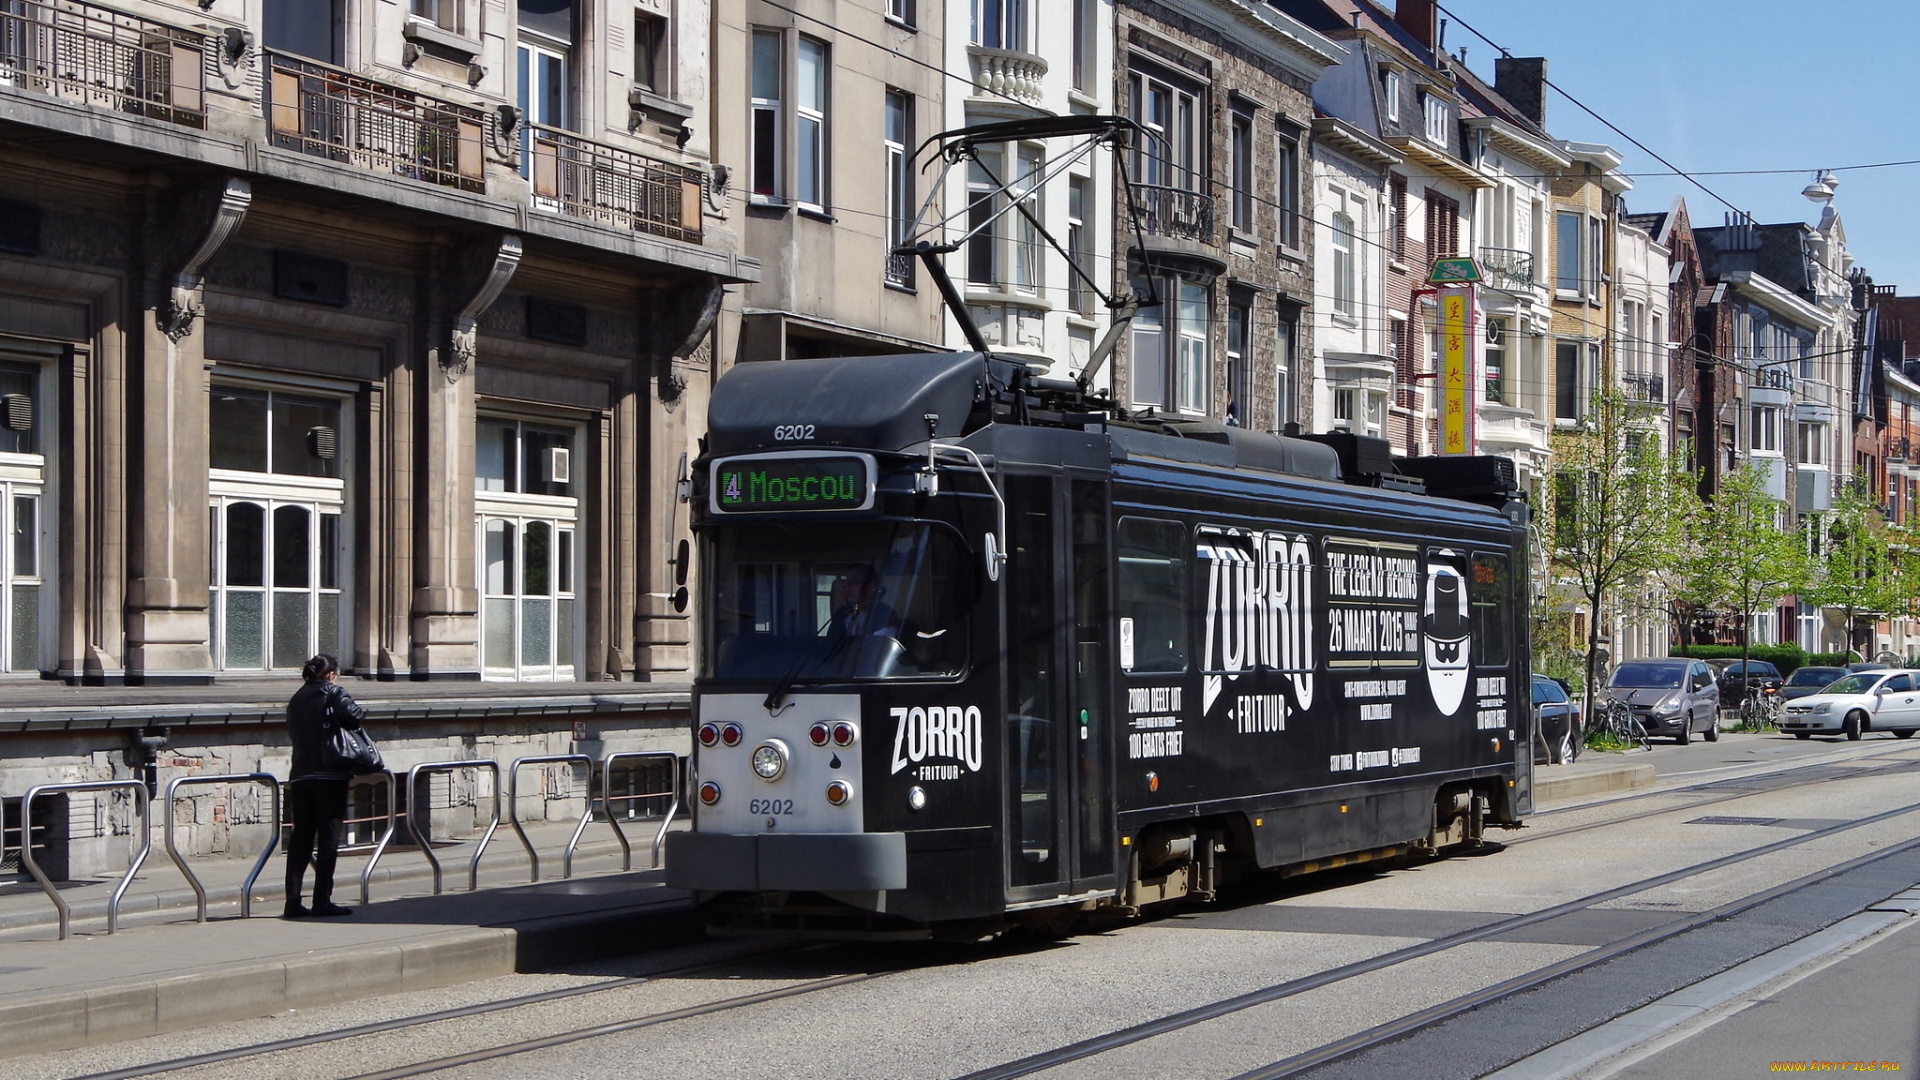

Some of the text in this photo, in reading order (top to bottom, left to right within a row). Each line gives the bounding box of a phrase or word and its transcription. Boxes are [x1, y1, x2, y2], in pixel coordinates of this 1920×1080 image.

[774, 424, 815, 440] 6202
[726, 471, 853, 502] 4 Moscou
[1327, 552, 1417, 599] THE LEGEND BEGINS
[1197, 526, 1314, 717] ZORRO
[1329, 608, 1403, 652] 26 MAART 2015
[1129, 686, 1182, 714] ZORRO DEELT UIT
[1238, 694, 1285, 734] FRITUUR
[890, 705, 982, 776] ZORRO
[1129, 731, 1183, 759] 100 GRATIS FRIET
[919, 766, 959, 781] FRITUUR
[750, 799, 793, 815] 6202
